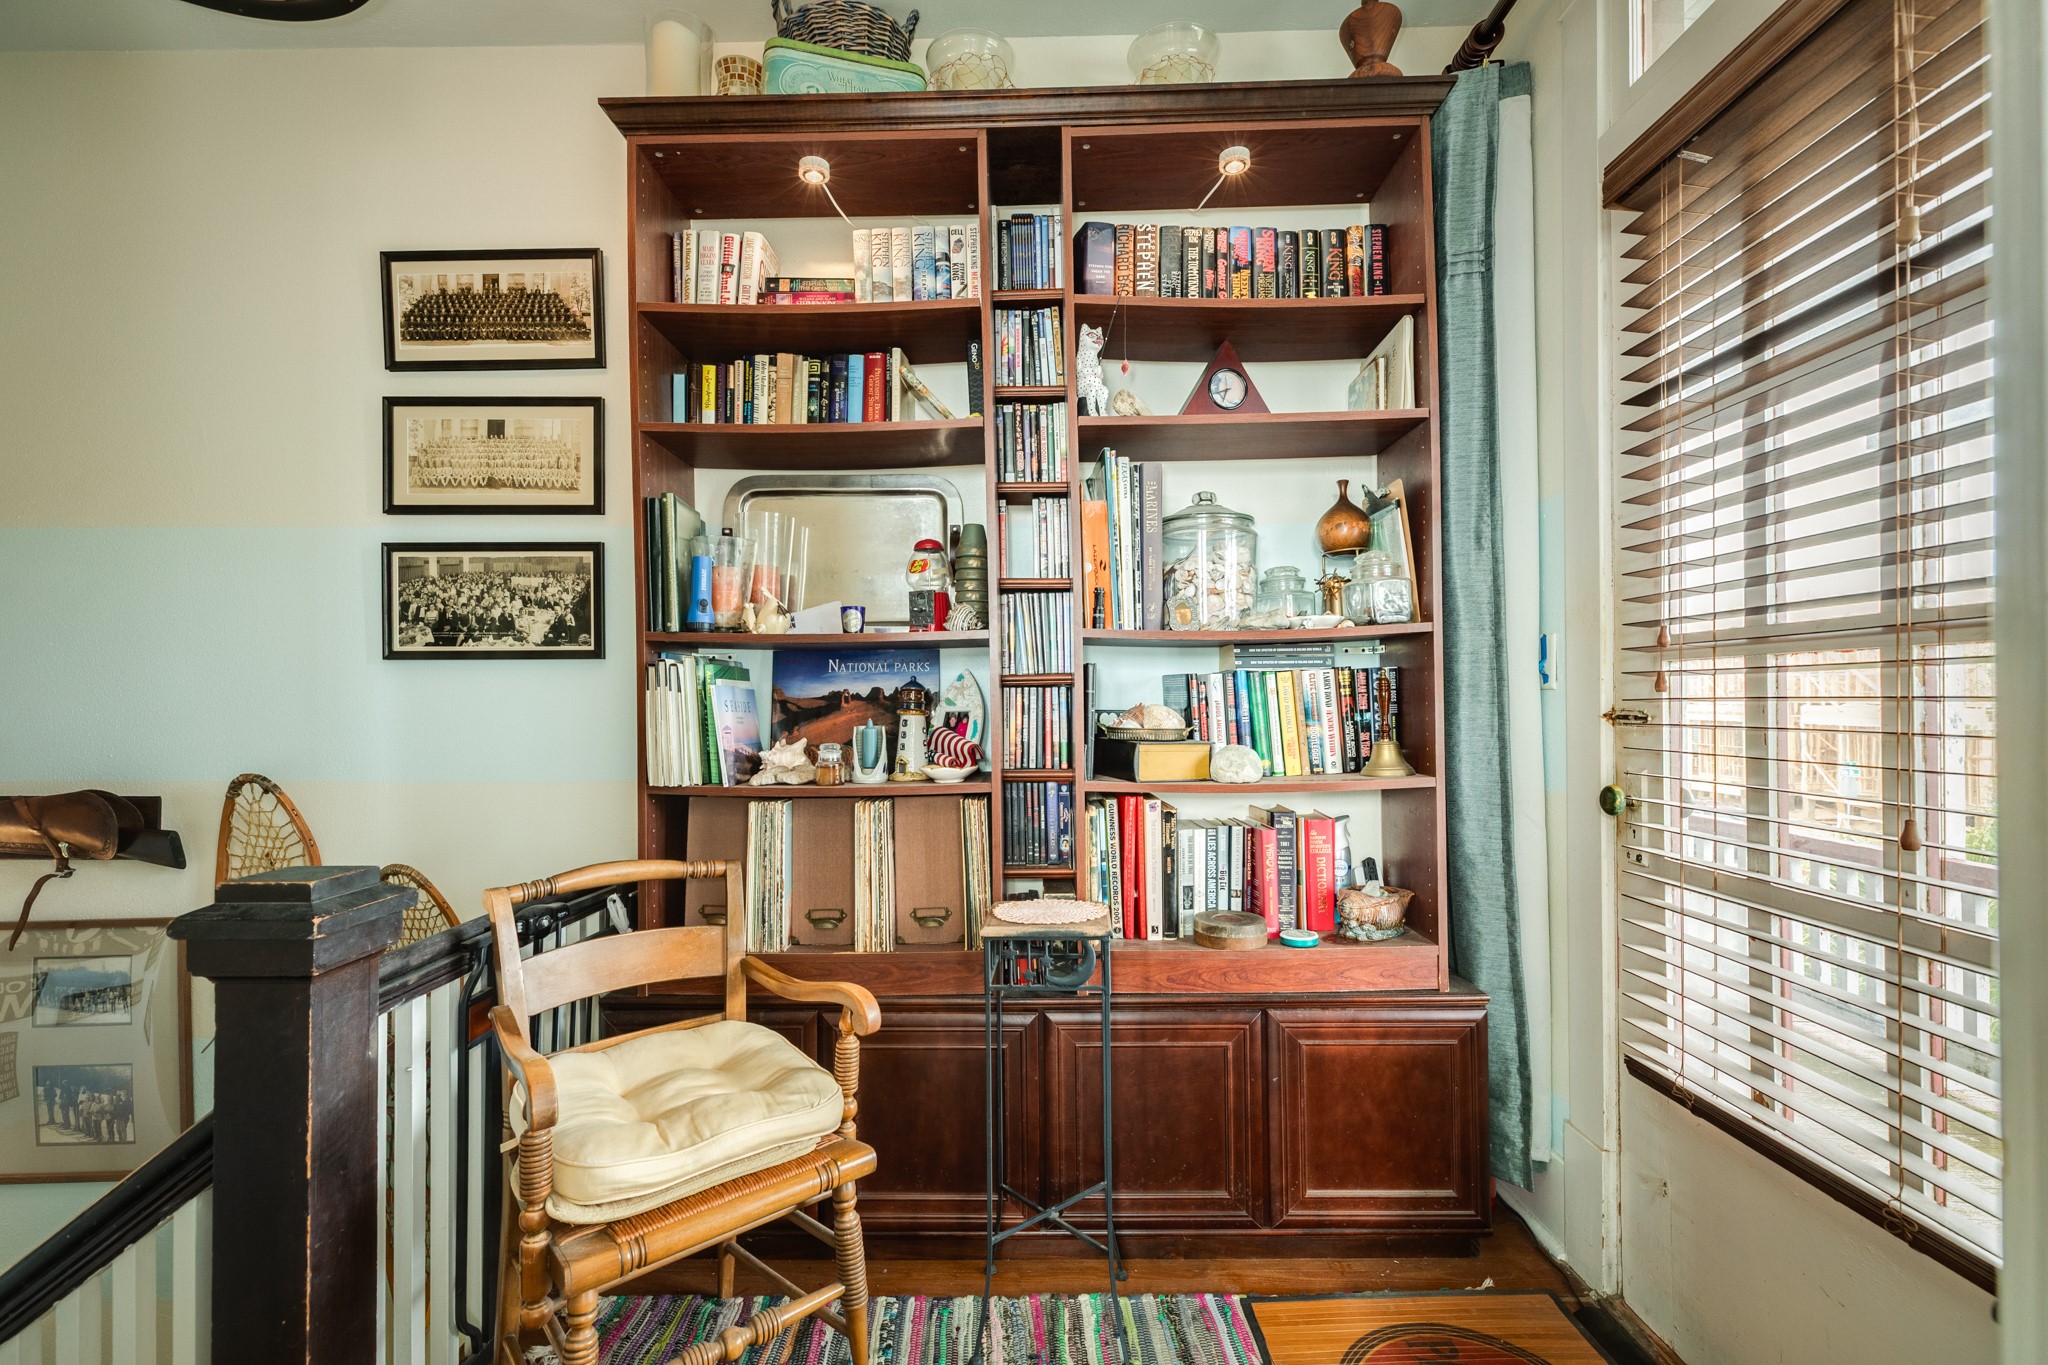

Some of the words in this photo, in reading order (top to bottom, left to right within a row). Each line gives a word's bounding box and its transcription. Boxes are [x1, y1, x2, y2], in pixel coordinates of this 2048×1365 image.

[951, 228, 964, 237] CELL
[970, 228, 978, 254] STEPHEN
[1183, 229, 1202, 237] STEPHEN
[1188, 236, 1199, 244] KING
[1207, 230, 1215, 254] STEPHEN
[1220, 230, 1228, 254] STEPHEN
[1372, 228, 1382, 260] STEPHEN
[724, 236, 735, 265] Griffin
[745, 238, 755, 253] JAMES
[872, 233, 882, 268] KING
[882, 232, 890, 268] STEPHEN
[893, 233, 903, 267] KING
[902, 232, 911, 267] STEPHEN
[914, 233, 925, 271] KING
[925, 232, 934, 270] STEPHEN
[1118, 224, 1130, 272] RICHARD
[1136, 224, 1151, 291] STEPHEN
[1187, 247, 1199, 260] THE
[1233, 236, 1241, 259] KING
[1238, 230, 1249, 265] STEPHEN
[1256, 237, 1266, 266] KING
[1262, 229, 1275, 273] STEPHEN
[1283, 245, 1294, 269] KING
[743, 254, 754, 280] PATTERSON
[970, 254, 978, 270] KING
[1304, 251, 1316, 272] KING
[1325, 247, 1343, 281] KING
[1373, 262, 1384, 280] KING
[970, 343, 979, 363] GENO
[1121, 462, 1129, 484] TEXAS
[1146, 486, 1158, 533] MARINES
[828, 659, 890, 673] NATIONAL
[894, 663, 931, 673] PARKS
[1309, 672, 1317, 691] CLIVE
[1322, 671, 1331, 690] LARRY
[1357, 671, 1368, 693] HARLAN
[1389, 671, 1397, 690] SOLDIER
[724, 700, 752, 713] SEASIDE
[1282, 686, 1290, 704] DAVID
[1324, 691, 1332, 708] BOND
[1358, 693, 1369, 710] COBEN
[1284, 705, 1293, 734] BALDACCI
[1326, 712, 1334, 733] ENEMY
[1216, 720, 1224, 744] AMERICA!
[1360, 732, 1370, 741] SIX
[1310, 727, 1320, 765] BOOTLEGGER
[1328, 734, 1337, 758] WITHIN
[1362, 741, 1371, 758] YEARS
[1108, 803, 1119, 841] GUINNESS
[1110, 842, 1120, 869] WORLD
[1207, 836, 1217, 851] LIES
[1264, 843, 1275, 868] WEIRD
[1207, 851, 1217, 878] ACROSS
[1218, 870, 1227, 881] Big
[1266, 868, 1275, 882] U.S.
[1111, 871, 1121, 906] RECORDS
[1207, 878, 1217, 909] AMERICA
[1219, 881, 1227, 891] Lie
[1316, 857, 1328, 914] DICTIONARY
[1113, 907, 1121, 925] 2005
